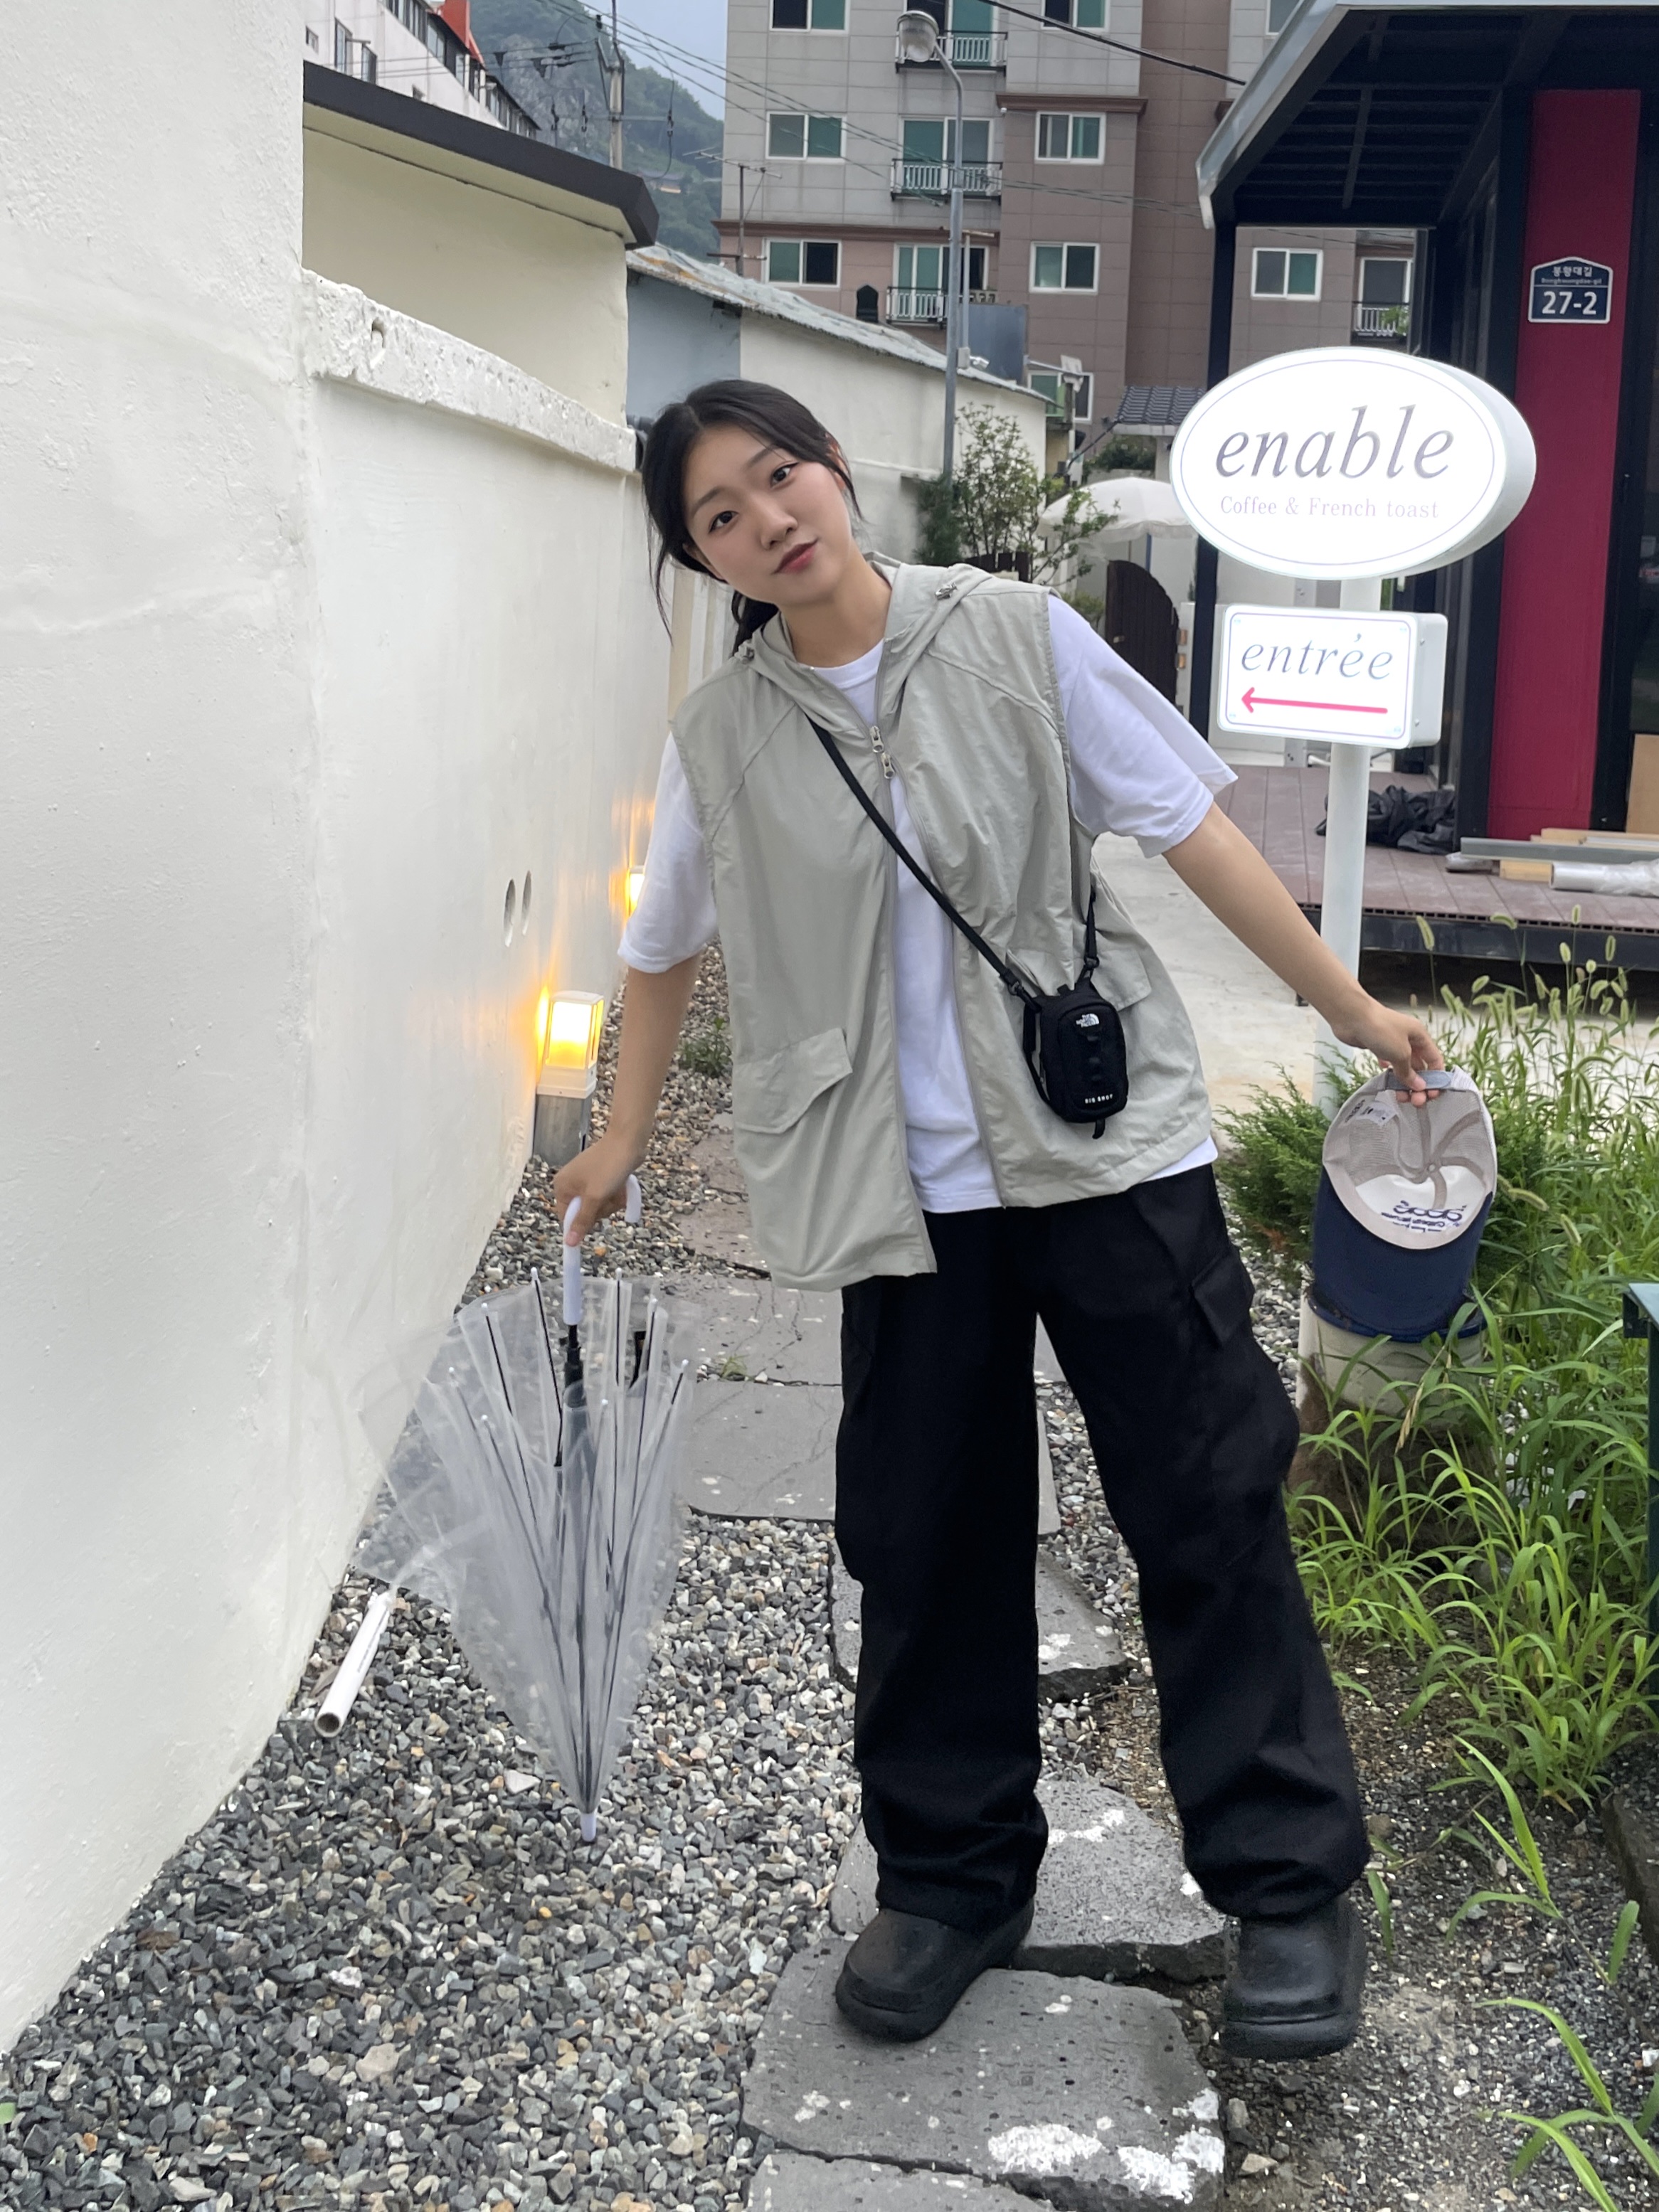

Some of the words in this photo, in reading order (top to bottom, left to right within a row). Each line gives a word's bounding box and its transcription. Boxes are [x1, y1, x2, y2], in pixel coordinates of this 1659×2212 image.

[1542, 291, 1597, 315] 27-2
[1216, 404, 1454, 479] enable
[1220, 495, 1278, 515] Coffee
[1285, 496, 1300, 516] &
[1308, 497, 1377, 517] French
[1387, 500, 1439, 519] toast
[1241, 632, 1394, 680] entrée
